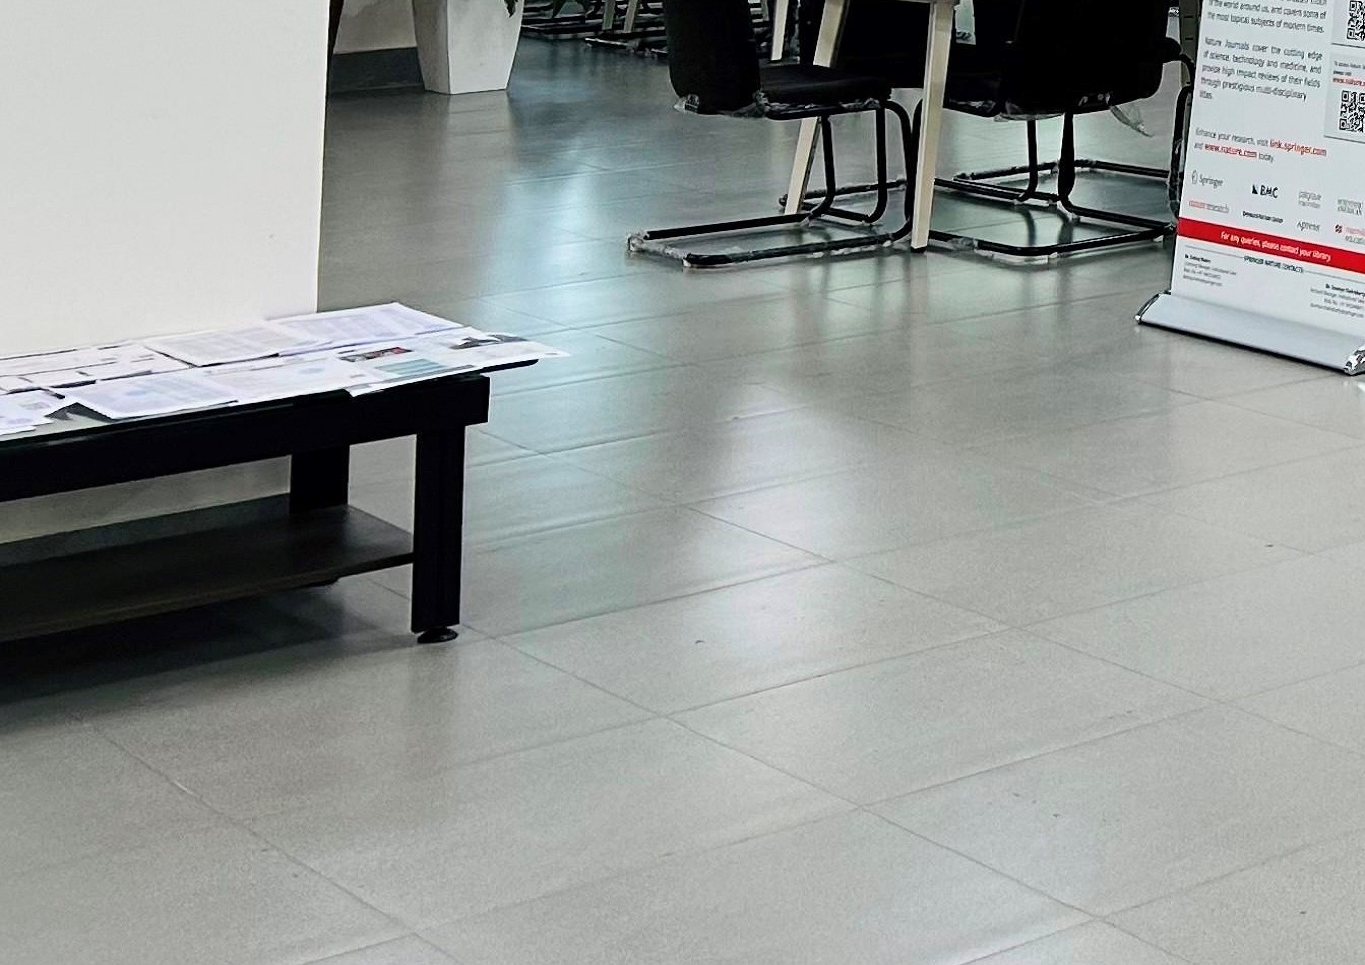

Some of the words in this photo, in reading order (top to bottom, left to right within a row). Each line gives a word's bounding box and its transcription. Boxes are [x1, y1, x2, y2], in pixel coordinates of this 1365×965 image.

[1198, 174, 1224, 191] Springer
[1259, 183, 1280, 200] BMC
[1220, 230, 1231, 242] For
[1299, 246, 1313, 258] your
